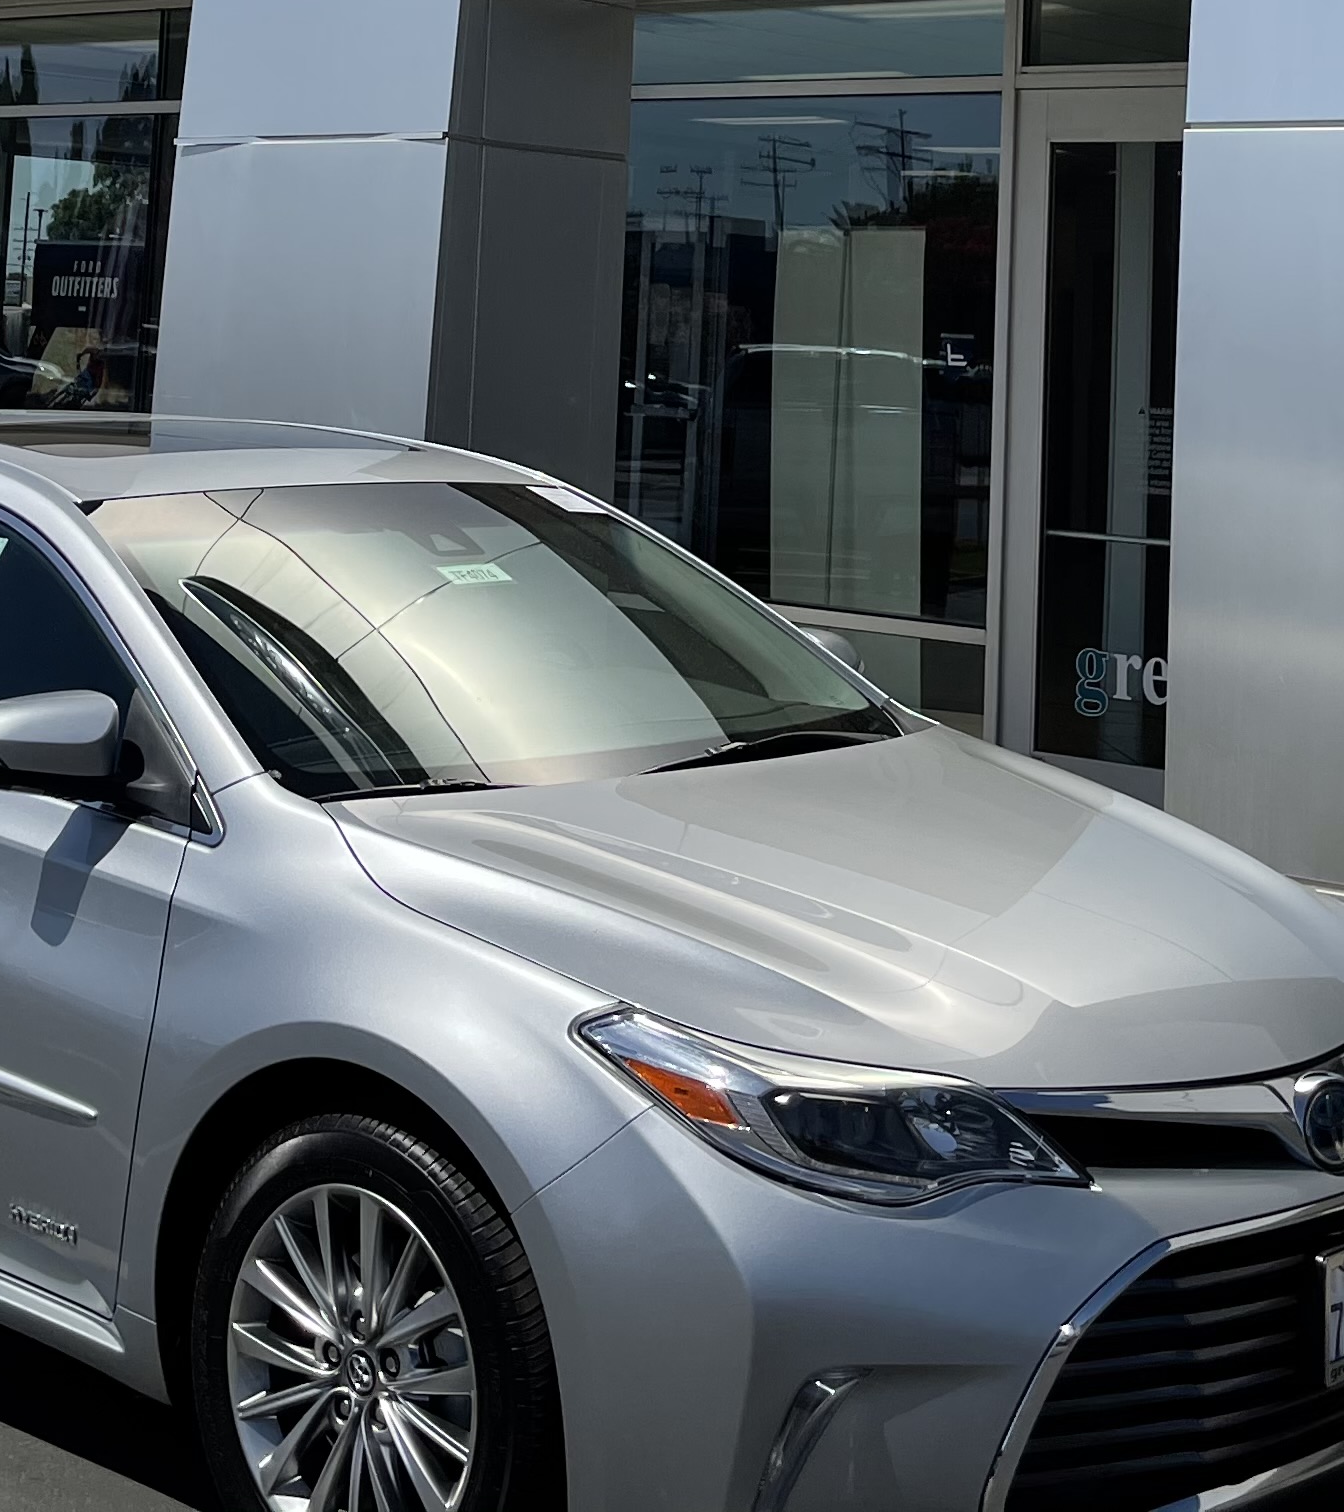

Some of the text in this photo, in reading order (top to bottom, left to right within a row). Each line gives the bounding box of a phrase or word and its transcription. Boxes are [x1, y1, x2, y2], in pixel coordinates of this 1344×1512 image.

[73, 260, 102, 273] FORD
[51, 275, 120, 299] OUTFITTERS
[1074, 648, 1168, 717] gre
